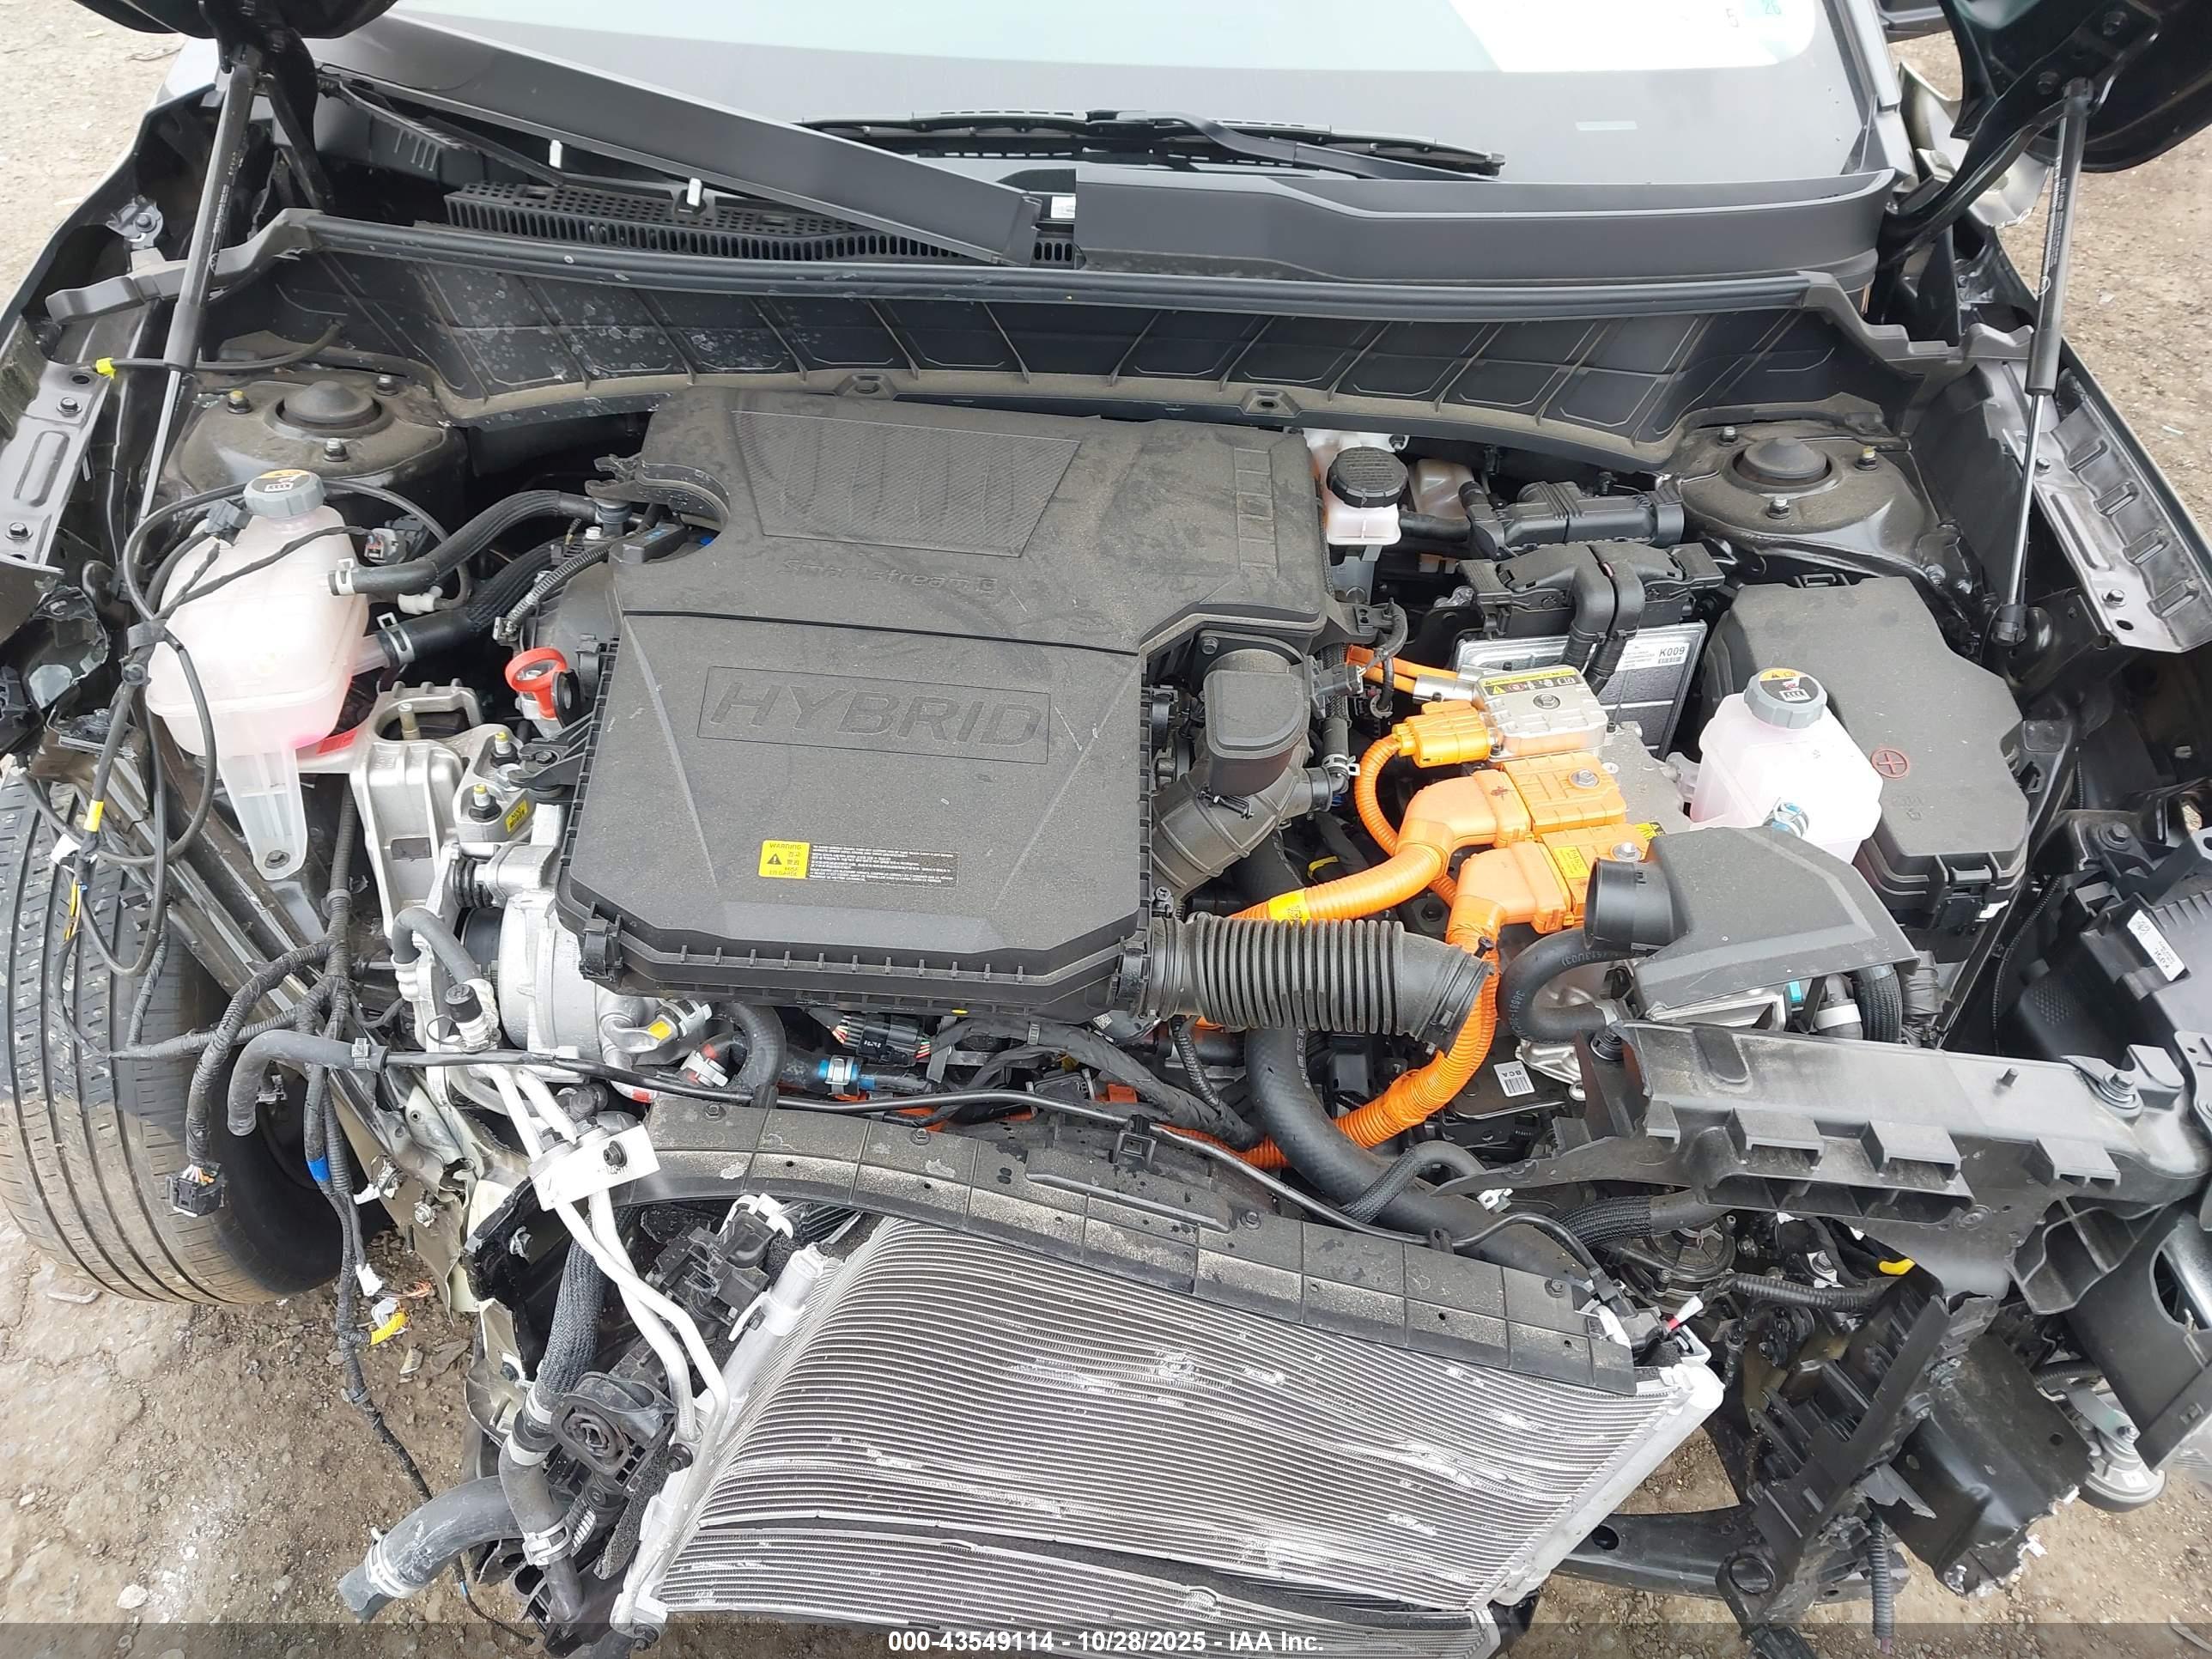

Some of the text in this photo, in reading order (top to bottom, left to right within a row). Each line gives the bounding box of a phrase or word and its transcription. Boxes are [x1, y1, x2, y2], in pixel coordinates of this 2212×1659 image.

[1658, 646, 1686, 658] K009
[709, 682, 1042, 747] HYBRID
[1500, 1069, 1522, 1078] BCA
